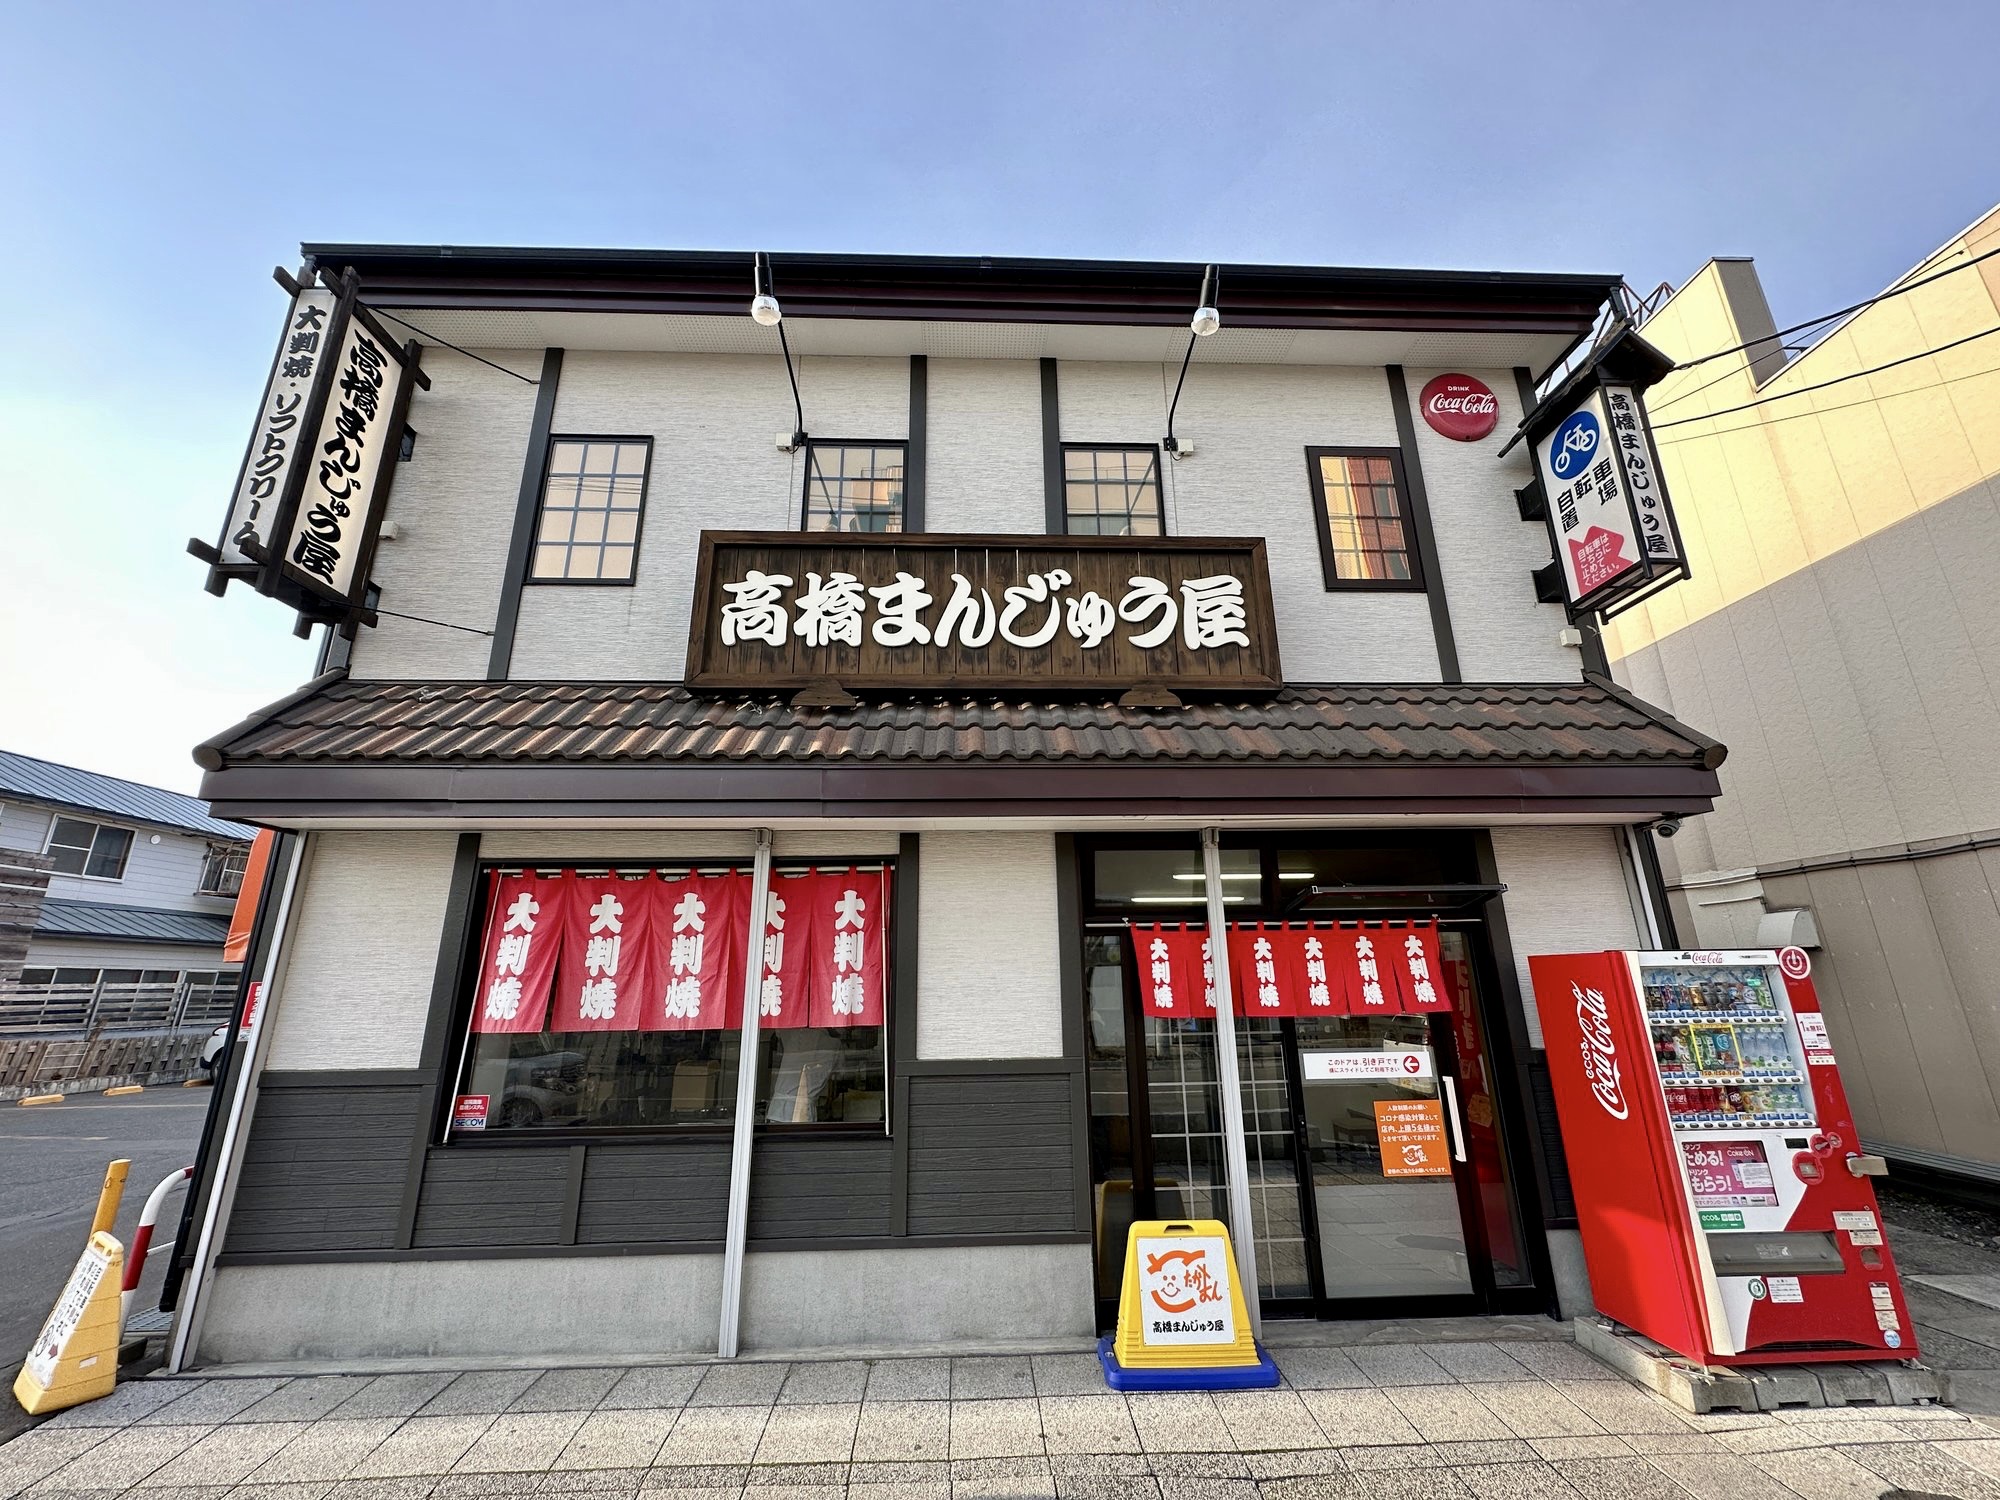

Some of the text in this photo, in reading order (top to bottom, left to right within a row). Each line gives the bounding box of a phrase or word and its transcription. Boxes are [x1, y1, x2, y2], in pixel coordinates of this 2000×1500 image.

[1429, 393, 1495, 414] Coca-Cola
[293, 328, 388, 585] 高橋まんじゅう屋
[1609, 393, 1669, 554] 高橋まんじゅう屋
[1582, 557, 1605, 580] 止めて
[720, 568, 1250, 651] 高橋まんじゅう屋
[484, 892, 540, 1021] 大判焼
[579, 893, 624, 1021] 大判焼
[664, 892, 707, 1020] 大判焼
[831, 889, 866, 1017] 大判焼
[1149, 937, 1174, 1009] 大判焼
[1253, 937, 1280, 1007] 大判焼
[1304, 936, 1331, 1008] 大判焼
[1355, 935, 1385, 1006] 大判焼
[1404, 934, 1437, 1004] 大判焼
[1570, 980, 1629, 1120] Coca-Cola
[1152, 1319, 1225, 1334] 高橋まんじゅう屋
